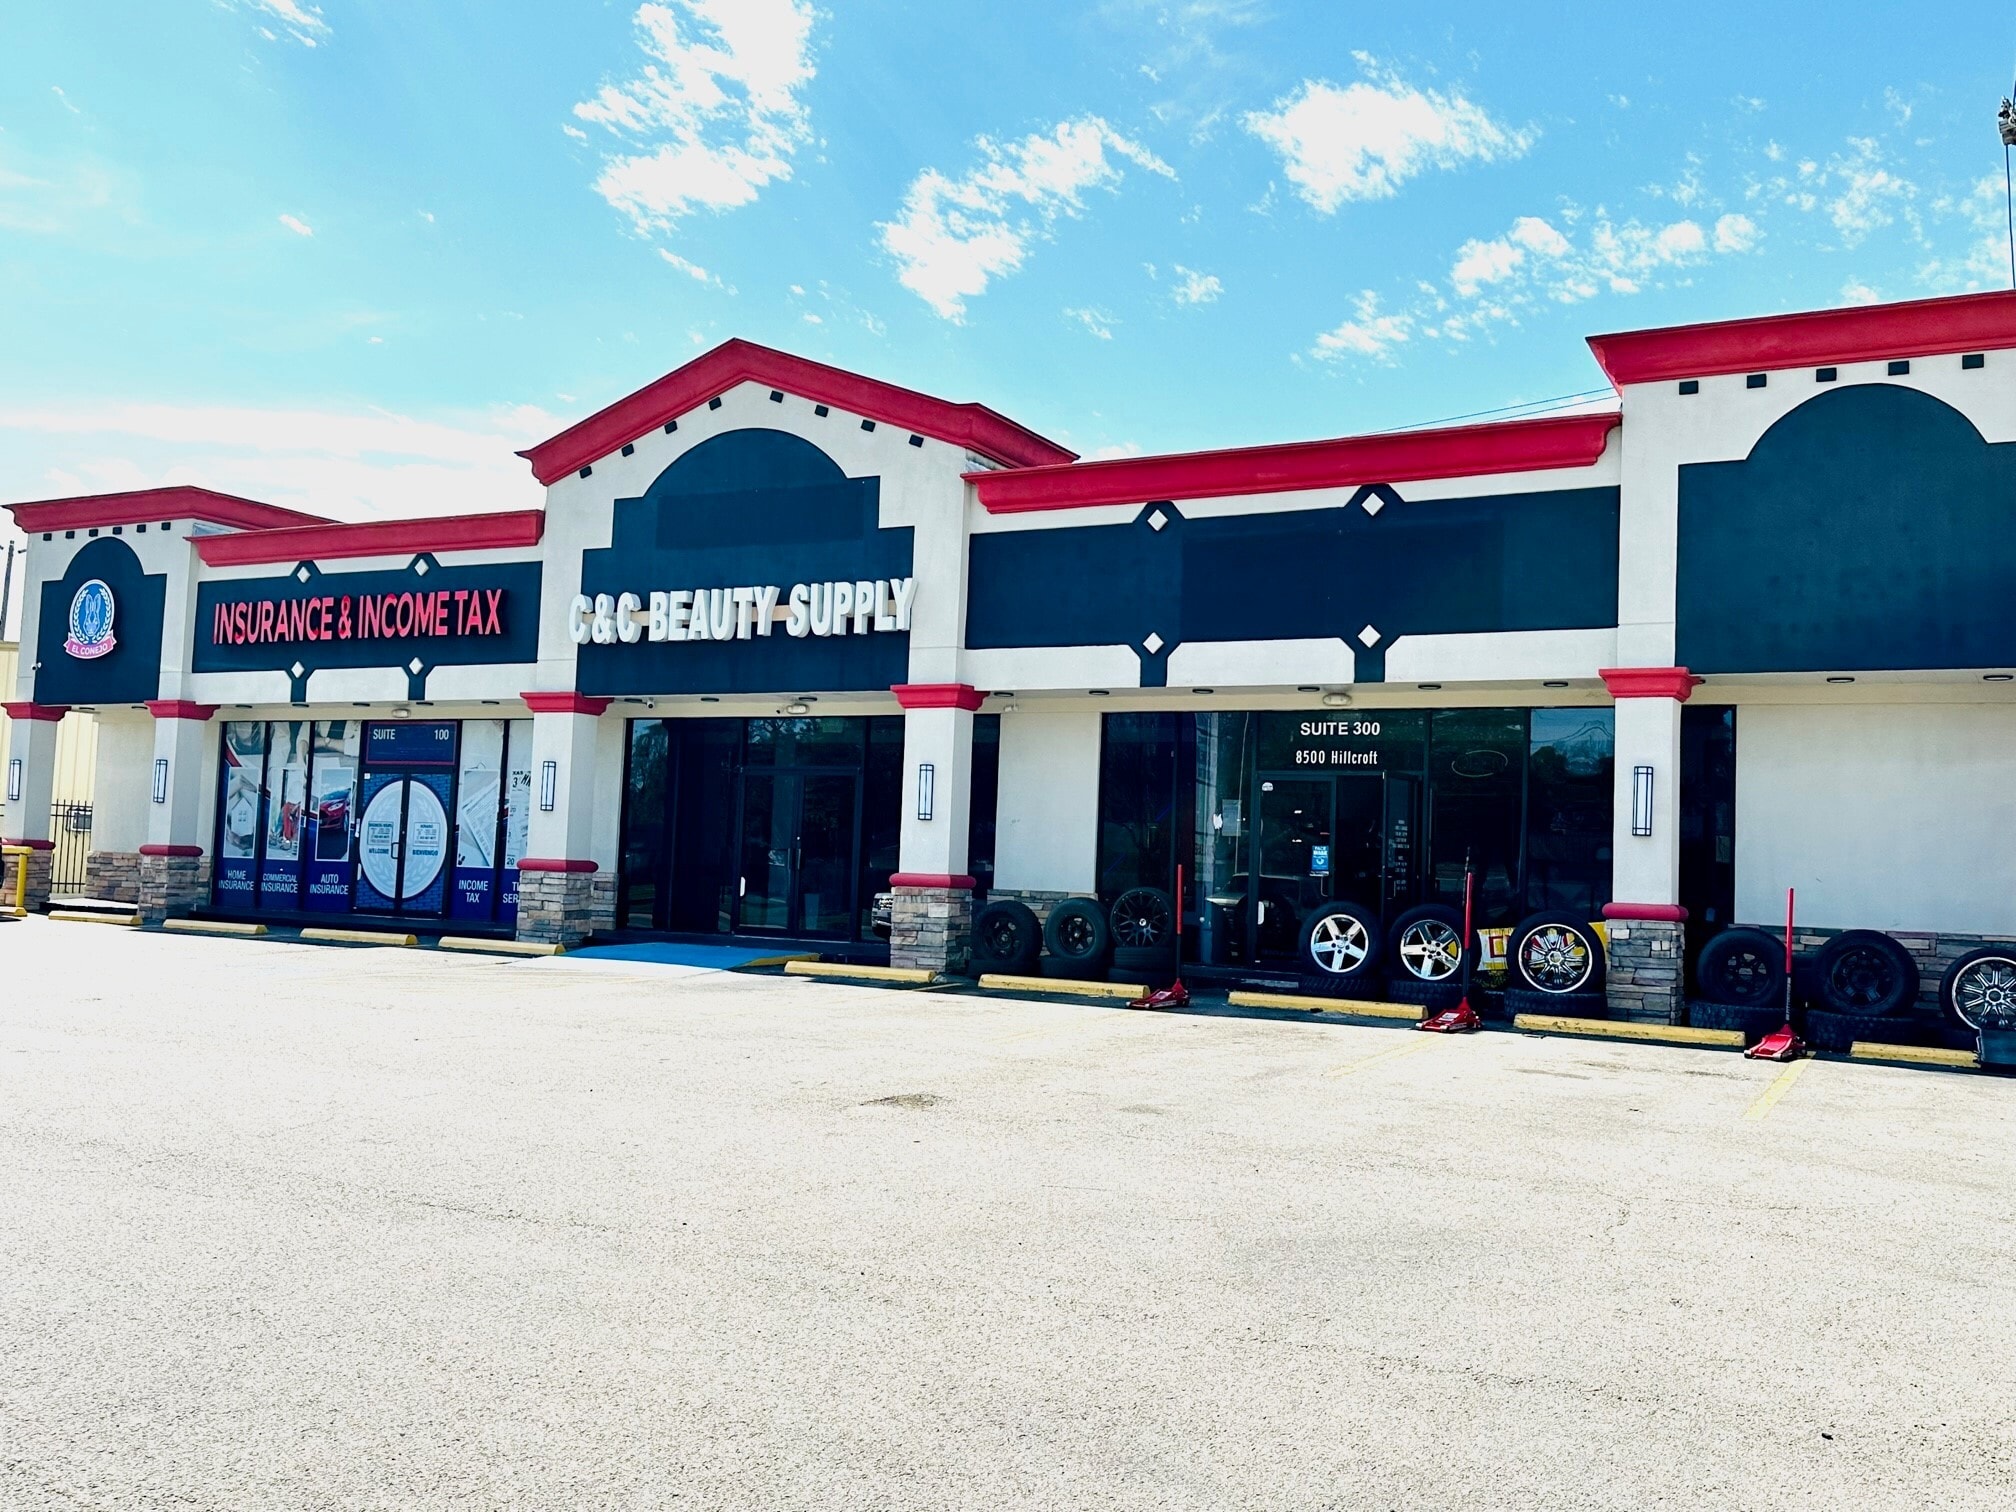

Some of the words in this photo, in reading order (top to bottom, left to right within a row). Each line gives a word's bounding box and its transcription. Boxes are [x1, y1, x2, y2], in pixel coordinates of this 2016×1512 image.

[213, 597, 334, 645] INSURANCE
[339, 594, 352, 640] &
[358, 590, 450, 639] INCOME
[454, 588, 502, 636] TAX
[568, 592, 641, 645] C&C
[648, 585, 780, 642] BEAUTY
[786, 577, 919, 638] SUPPLY
[71, 644, 80, 654] EL
[80, 643, 108, 655] CONEJO
[372, 728, 396, 740] SUITE
[434, 729, 450, 740] 100
[1300, 721, 1349, 736] SUITE
[1352, 721, 1381, 736] 300
[1295, 750, 1326, 764] 8500
[1331, 750, 1378, 765] Hillcroft
[227, 869, 247, 880] HOME
[262, 873, 297, 883] COMMERCIAL
[320, 873, 339, 884] AUTO
[218, 879, 254, 891] INSURANCE
[261, 882, 298, 894] INSURANCE
[309, 884, 349, 895] INSURANCE
[458, 879, 489, 891] INCOME
[465, 892, 480, 903] TAX
